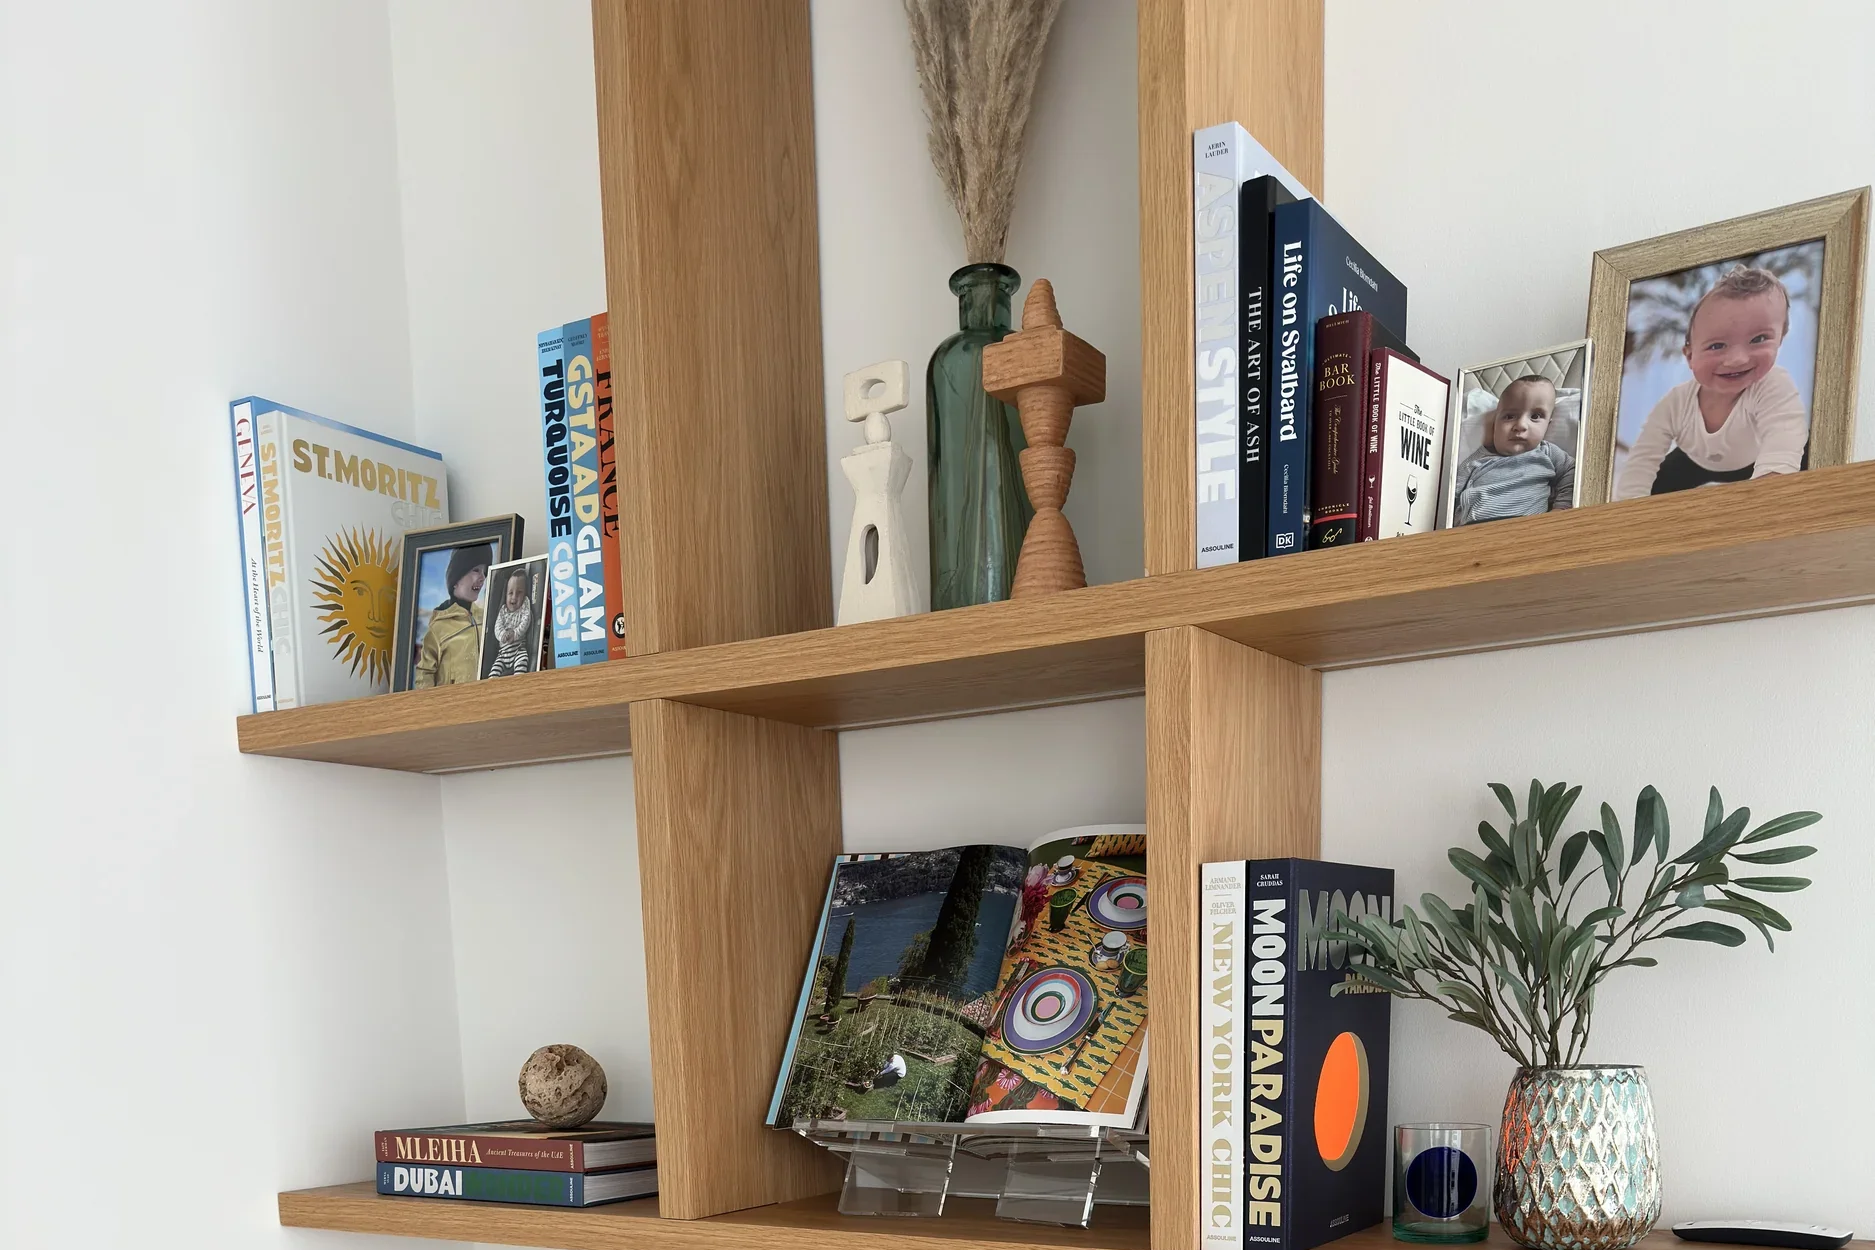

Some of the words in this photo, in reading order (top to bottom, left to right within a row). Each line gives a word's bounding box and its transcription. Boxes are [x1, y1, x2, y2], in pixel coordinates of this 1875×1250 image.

[1205, 148, 1229, 159] LAUDER
[1208, 141, 1226, 151] AERIN
[1197, 172, 1236, 343] ASPEN
[1283, 241, 1303, 288] Life
[1249, 287, 1262, 333] THE
[1282, 292, 1298, 326] on
[1248, 339, 1261, 381] ART
[1324, 363, 1350, 378] BAR
[1247, 387, 1260, 415] OF
[1280, 329, 1300, 442] Svalbard
[1319, 374, 1356, 392] BOOK
[1372, 376, 1381, 402] LITTLE
[1198, 346, 1236, 505] STYLE
[1371, 404, 1380, 423] BOOK
[1371, 424, 1378, 433] OF
[1399, 411, 1416, 428] LITTLE
[1416, 419, 1429, 434] BOOK
[1429, 425, 1436, 437] OF
[543, 358, 572, 538] TURQUOISE
[567, 355, 601, 525] GSTAAD
[1246, 421, 1260, 463] ASH
[1369, 435, 1378, 454] WINE
[1401, 425, 1432, 471] WINE
[236, 418, 256, 515] GENEVA
[292, 438, 441, 510] ST.MORITZ
[260, 442, 285, 587] ST.MORITZ
[1201, 543, 1234, 553] ASSOULINE
[1278, 535, 1292, 545] DK
[551, 541, 578, 642] COAST
[576, 524, 606, 642] GLAM
[256, 628, 264, 653] World
[1209, 876, 1237, 884] ARMAND
[1260, 873, 1280, 881] SARAH
[1212, 921, 1233, 1013] NEW
[1251, 899, 1286, 1016] MOON
[1212, 1020, 1233, 1129] YORK
[1248, 1019, 1284, 1227] PARADISE
[395, 1136, 483, 1164] MLEIHA
[486, 1148, 507, 1156] Ancient
[507, 1149, 534, 1158] Treasures
[550, 1151, 564, 1159] UAE
[394, 1166, 463, 1196] DUBAI
[1212, 1138, 1232, 1228] CHIC
[1206, 1234, 1237, 1242] ASSOULINE
[1249, 1236, 1281, 1244] ASSOULINE
